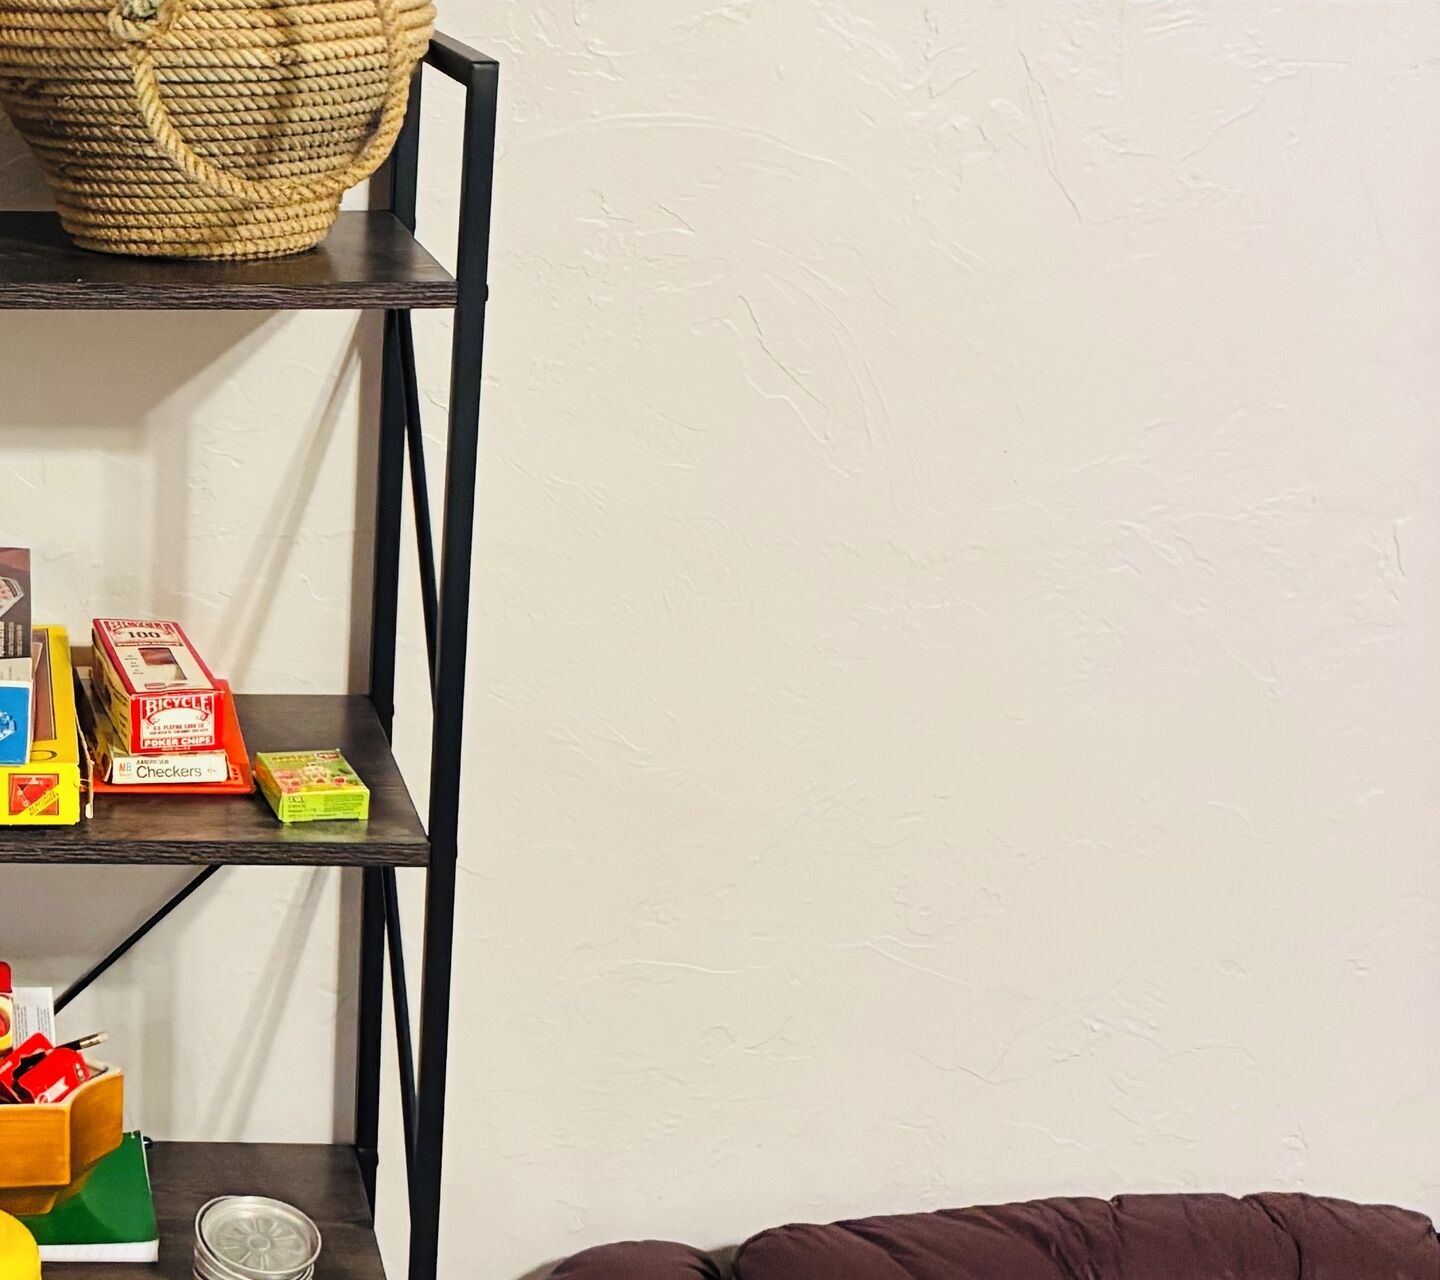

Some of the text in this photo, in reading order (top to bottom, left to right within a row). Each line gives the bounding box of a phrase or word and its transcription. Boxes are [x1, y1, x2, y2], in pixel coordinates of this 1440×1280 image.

[128, 631, 161, 639] 100
[145, 694, 211, 717] BICYCLE
[144, 736, 211, 747] POKER CHIPS
[136, 765, 202, 778] Checkers
